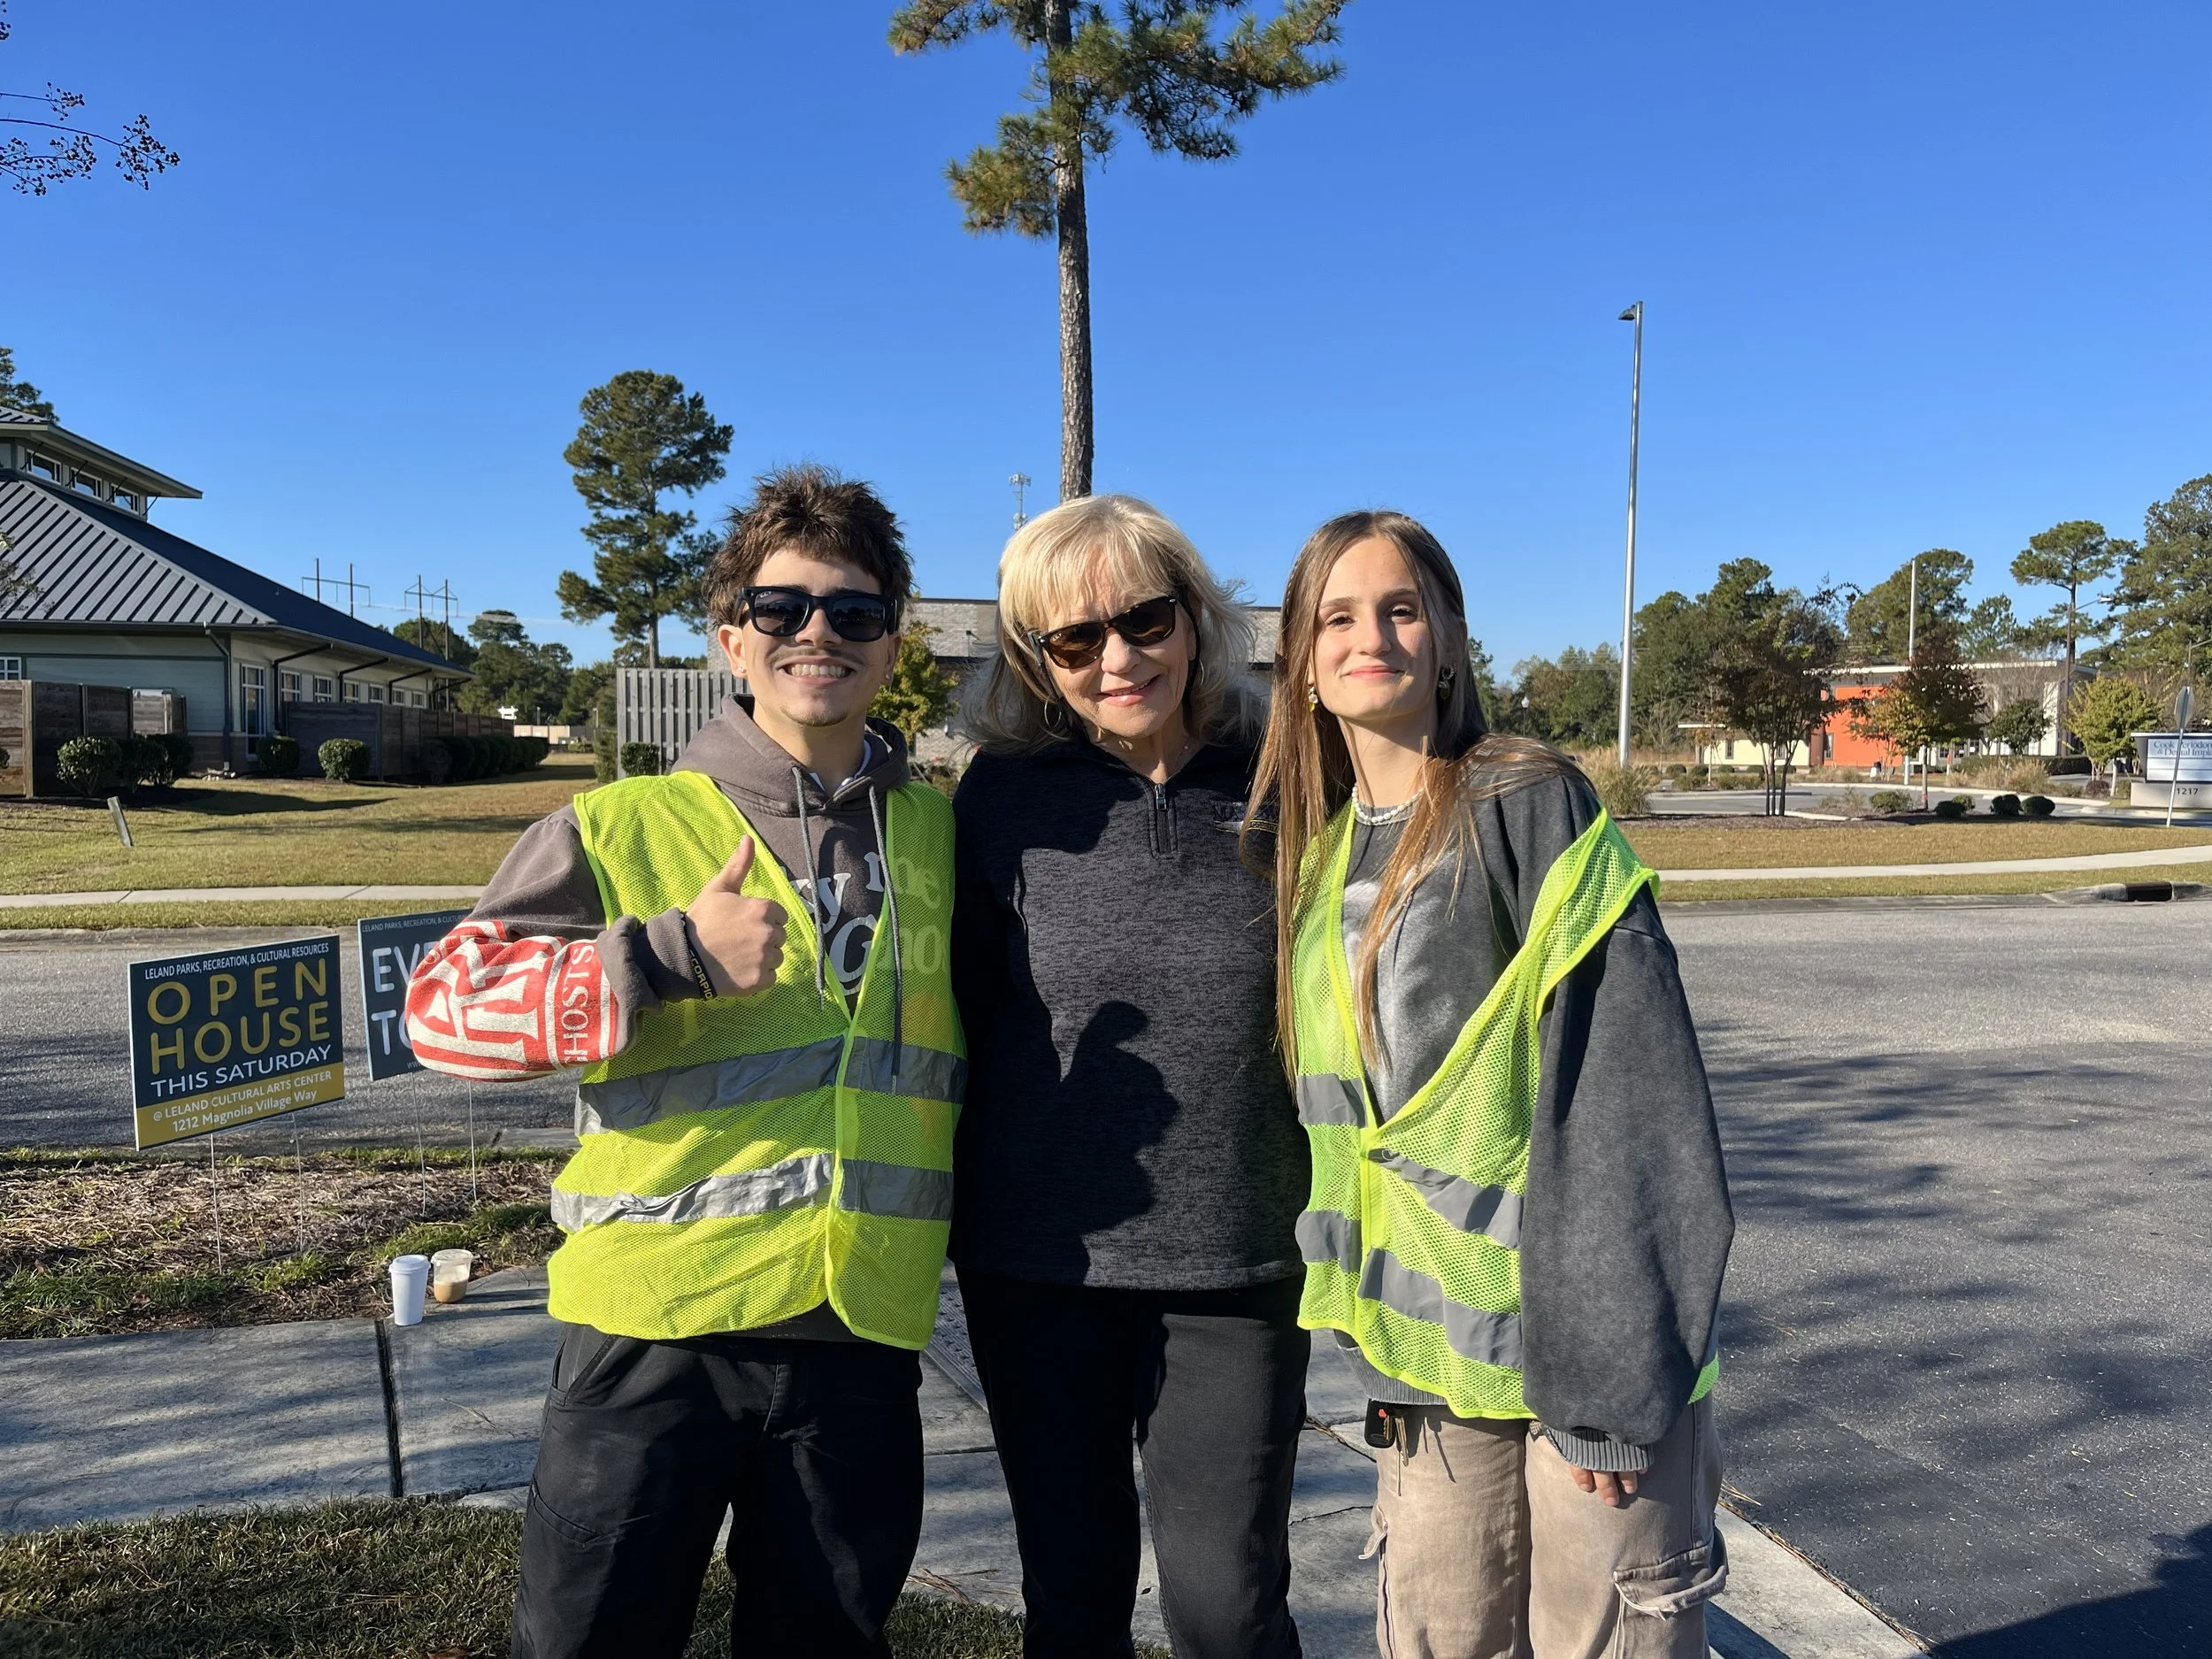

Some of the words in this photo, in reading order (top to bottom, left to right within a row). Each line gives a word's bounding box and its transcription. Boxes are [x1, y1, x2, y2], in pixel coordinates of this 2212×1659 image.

[2154, 740, 2174, 749] Cook
[362, 923, 384, 933] LELAND
[384, 920, 403, 930] PARKS,
[403, 917, 438, 928] RECREATION,
[145, 964, 175, 980] LELAND
[176, 961, 203, 974] PARKS,
[203, 955, 250, 971] RECREATION,
[250, 955, 257, 964] &
[257, 948, 291, 963] CULTURAL
[292, 942, 329, 957] RESOURCES
[147, 957, 327, 1025] OPEN
[561, 944, 595, 1063] HOSTS
[150, 1001, 330, 1074] HOUSE
[150, 1071, 209, 1097] THIS
[215, 1044, 332, 1085] SATURDAY
[153, 1111, 163, 1122] @
[165, 1099, 209, 1118] LELAND
[211, 1087, 265, 1108] CULTURAL
[266, 1079, 292, 1095] ARTS
[293, 1070, 332, 1088] CENTER
[172, 1118, 199, 1133] 1212
[203, 1103, 253, 1125] Magnolia
[256, 1094, 292, 1110] Village
[294, 1089, 318, 1102] Way
